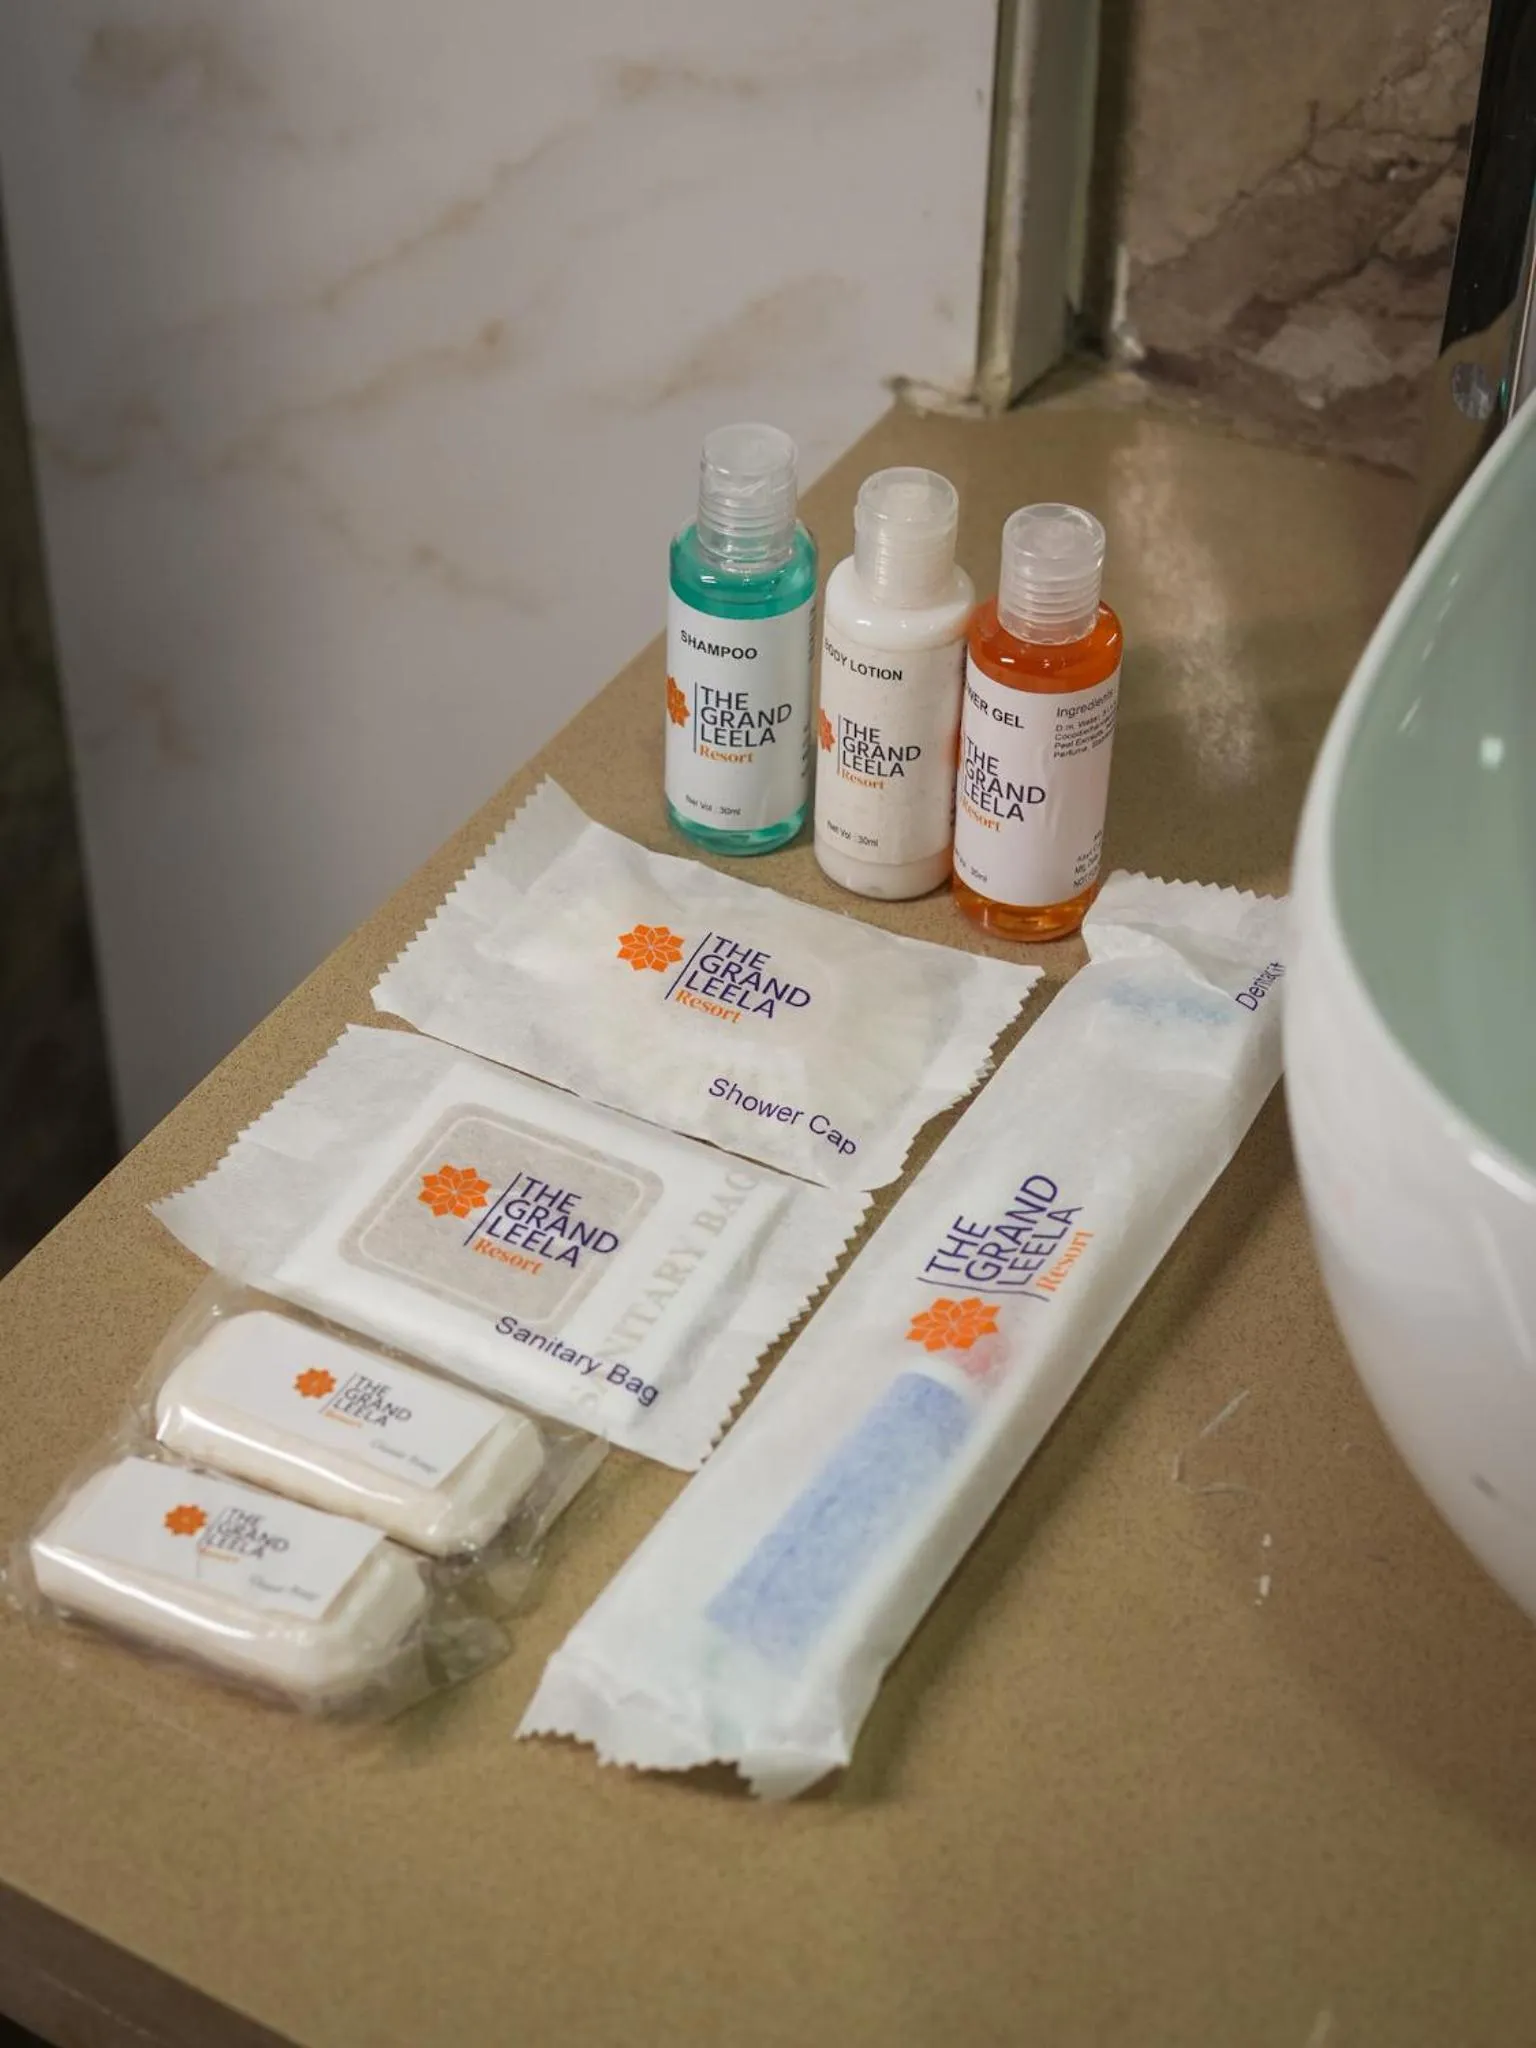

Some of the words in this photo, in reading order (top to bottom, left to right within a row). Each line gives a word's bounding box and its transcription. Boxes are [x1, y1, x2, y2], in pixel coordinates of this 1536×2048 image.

[680, 629, 758, 660] SHAMPOO
[850, 659, 903, 681] LOTION
[700, 685, 749, 711] THE
[700, 703, 792, 729] GRAND
[700, 723, 776, 748] LEELA
[842, 717, 882, 745] THE
[992, 707, 1025, 729] GEL
[700, 744, 753, 763] Resort
[842, 736, 921, 762] GRAND
[842, 749, 905, 777] LEELA
[966, 736, 1000, 776] THE
[841, 767, 886, 790] Resort
[965, 758, 1046, 805] GRAND
[964, 775, 1025, 822] LEELA
[713, 935, 771, 972] THE
[684, 970, 776, 1019] LEELA
[699, 954, 811, 1009] GRAND
[674, 988, 743, 1024] Resort
[708, 1077, 805, 1126] Shower
[808, 1114, 857, 1156] Cap
[521, 1176, 582, 1216] THE
[486, 1215, 581, 1268] LEELA
[504, 1199, 620, 1255] GRAND
[924, 1215, 991, 1273] THE
[965, 1174, 1058, 1282] GRAND
[472, 1237, 545, 1276] Resort
[996, 1206, 1084, 1285] LEELA
[495, 1315, 604, 1376] Sanitary
[605, 1363, 660, 1407] Bag
[354, 1375, 393, 1397] THE
[333, 1398, 389, 1427] LEELA
[345, 1387, 412, 1422] GRAND
